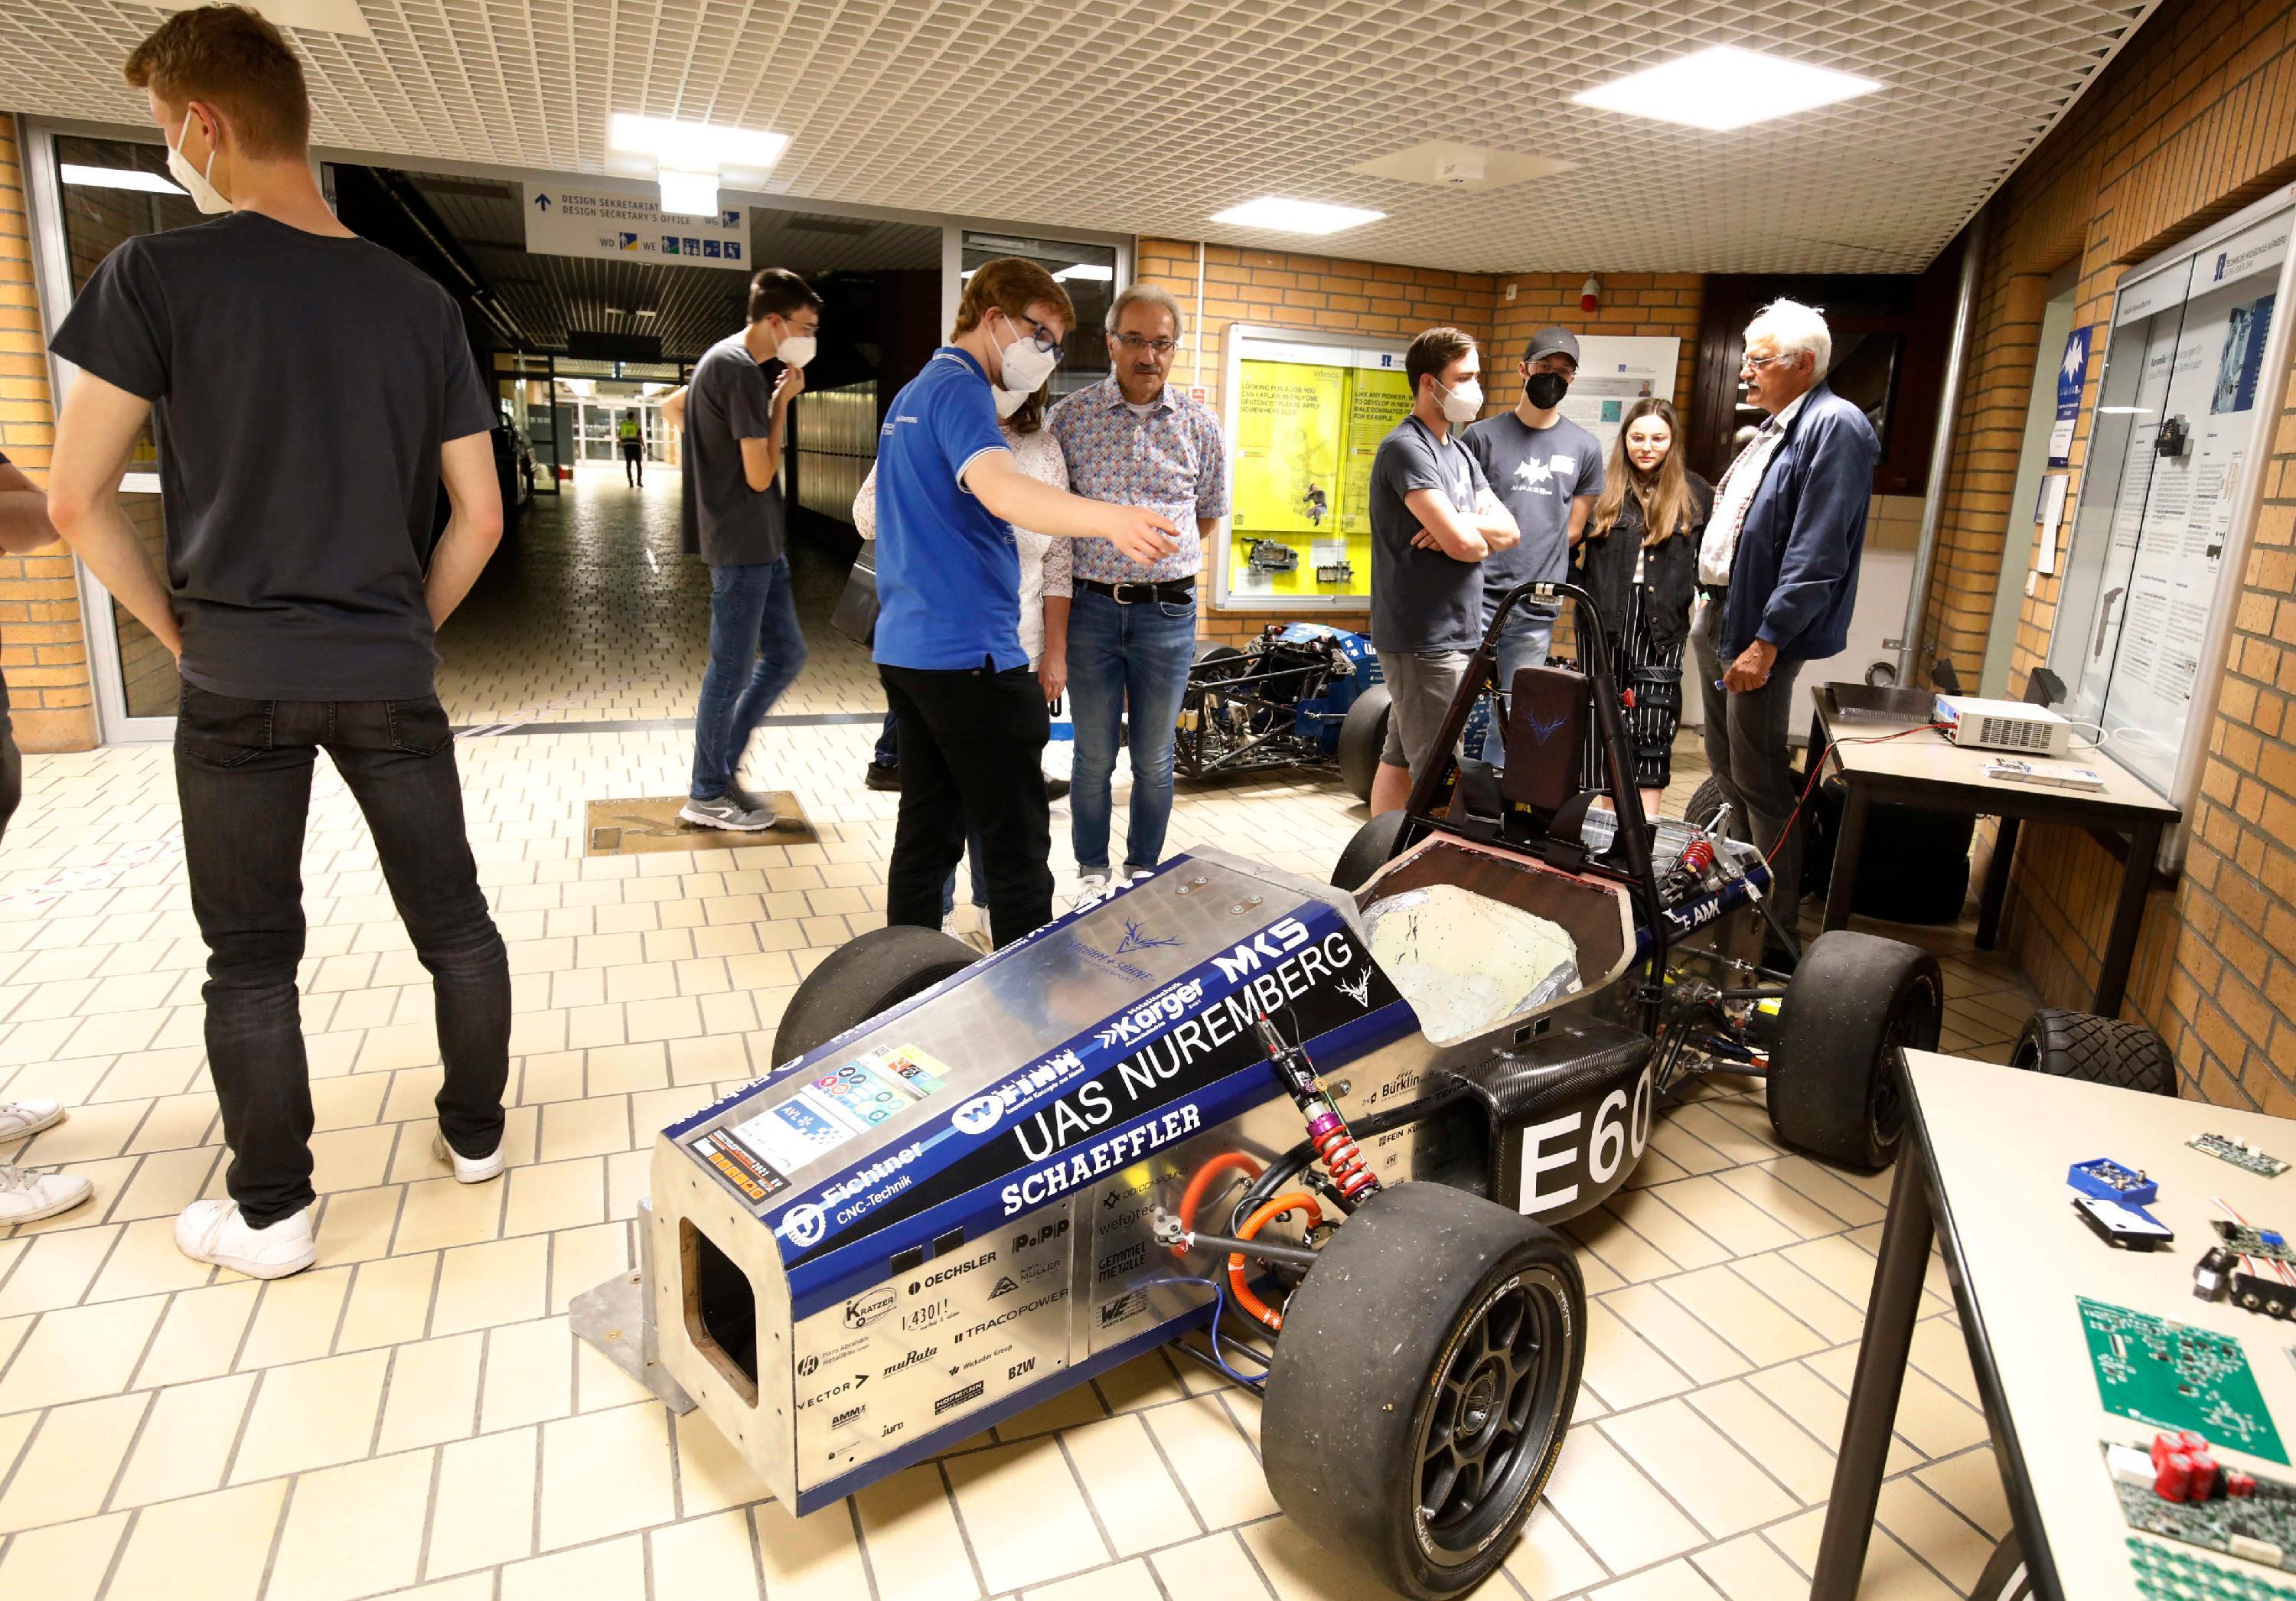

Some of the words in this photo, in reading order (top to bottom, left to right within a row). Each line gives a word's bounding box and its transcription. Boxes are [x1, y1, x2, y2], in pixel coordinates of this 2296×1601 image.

[563, 195, 595, 205] DESIGN
[599, 199, 660, 211] SEKRETARIAT
[563, 205, 596, 216] DESIGN
[600, 209, 657, 223] SECRETARY'S
[660, 214, 692, 225] OFFICE
[599, 238, 615, 247] WD
[643, 241, 657, 250] WE
[1211, 917, 1311, 983] MKS
[1112, 977, 1204, 1042] Karger
[1013, 1081, 1113, 1162] UAS
[1117, 931, 1353, 1100] NUREMBERG
[1382, 1074, 1420, 1097] Bürklin
[1005, 1097, 1034, 1114] Innovative
[1518, 1066, 1652, 1215] E60
[1001, 1104, 1200, 1216] SCHAEFFLER
[820, 1140, 923, 1208] Fichtner
[837, 1175, 912, 1225] CNC-Technik
[925, 1251, 996, 1287] OECHSLER
[1098, 1254, 1146, 1283] METALLE
[846, 1296, 894, 1322] KRATZER
[822, 1348, 839, 1358] Hans
[841, 1336, 869, 1351] Abraham
[822, 1349, 856, 1366] Metallbau
[883, 1346, 938, 1375] muRata
[963, 1352, 992, 1370] Wickeder
[993, 1345, 1013, 1357] Group
[1008, 1357, 1035, 1380] BZW
[797, 1382, 851, 1410] VECTOR
[936, 1382, 983, 1408] HOFMANN
